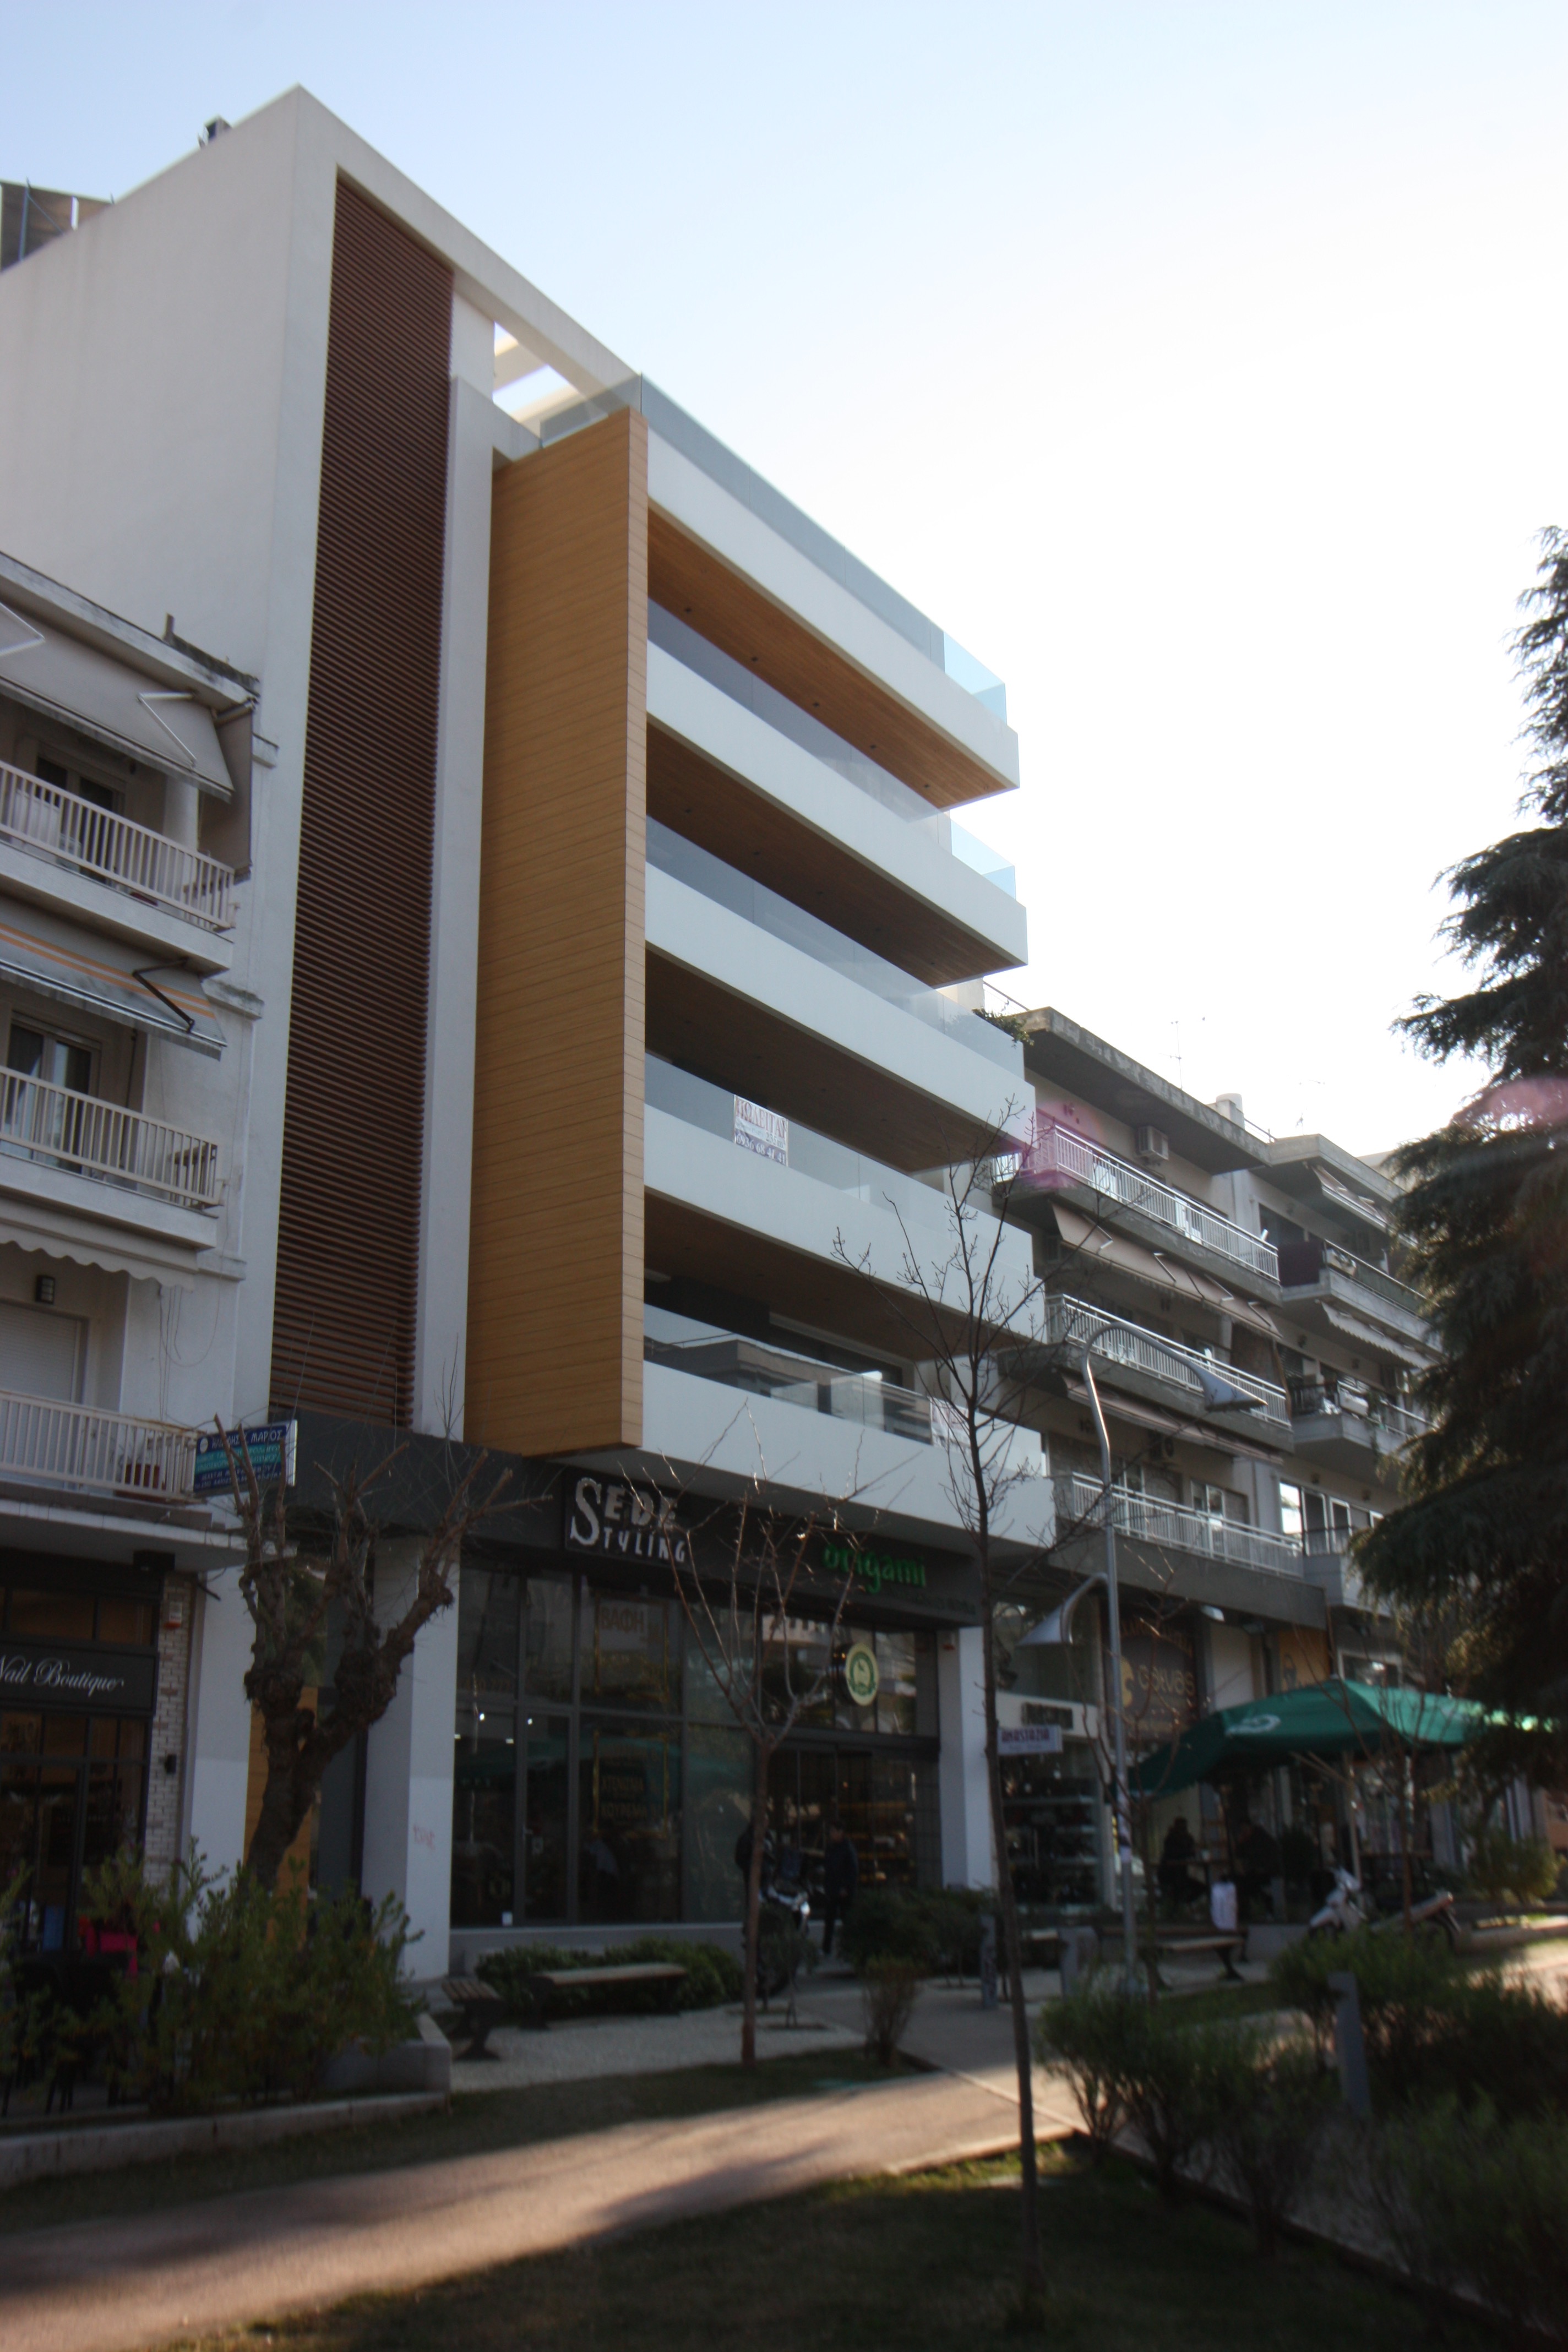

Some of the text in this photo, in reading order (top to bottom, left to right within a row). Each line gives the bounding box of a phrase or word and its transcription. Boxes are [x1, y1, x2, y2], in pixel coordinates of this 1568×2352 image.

[736, 1133, 754, 1150] 6936
[756, 1142, 765, 1155] 68
[822, 1543, 927, 1594] origami
[34, 1657, 124, 1698] Boutique
